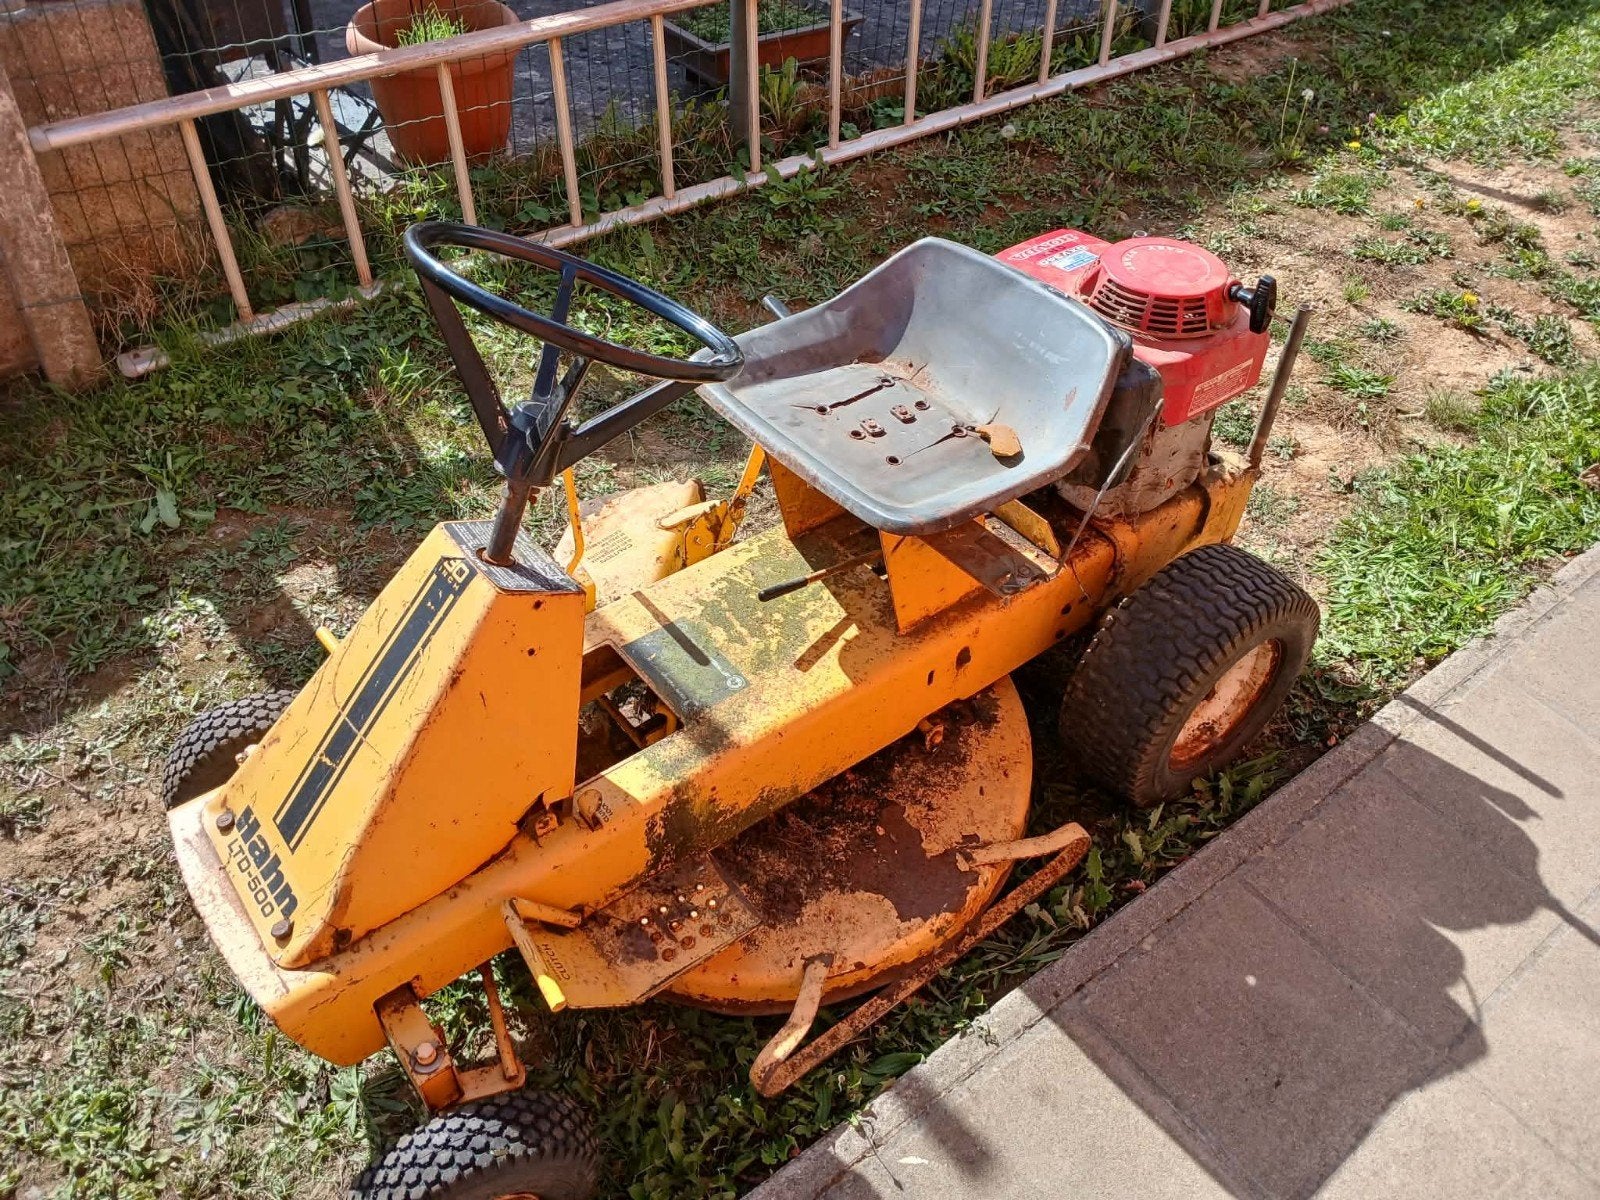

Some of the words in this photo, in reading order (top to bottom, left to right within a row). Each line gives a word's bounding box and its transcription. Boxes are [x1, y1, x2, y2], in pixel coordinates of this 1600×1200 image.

[1008, 234, 1079, 260] HONDA
[227, 838, 275, 918] LTD-500
[235, 804, 298, 919] Hahn
[541, 944, 571, 980] CLUTCH
